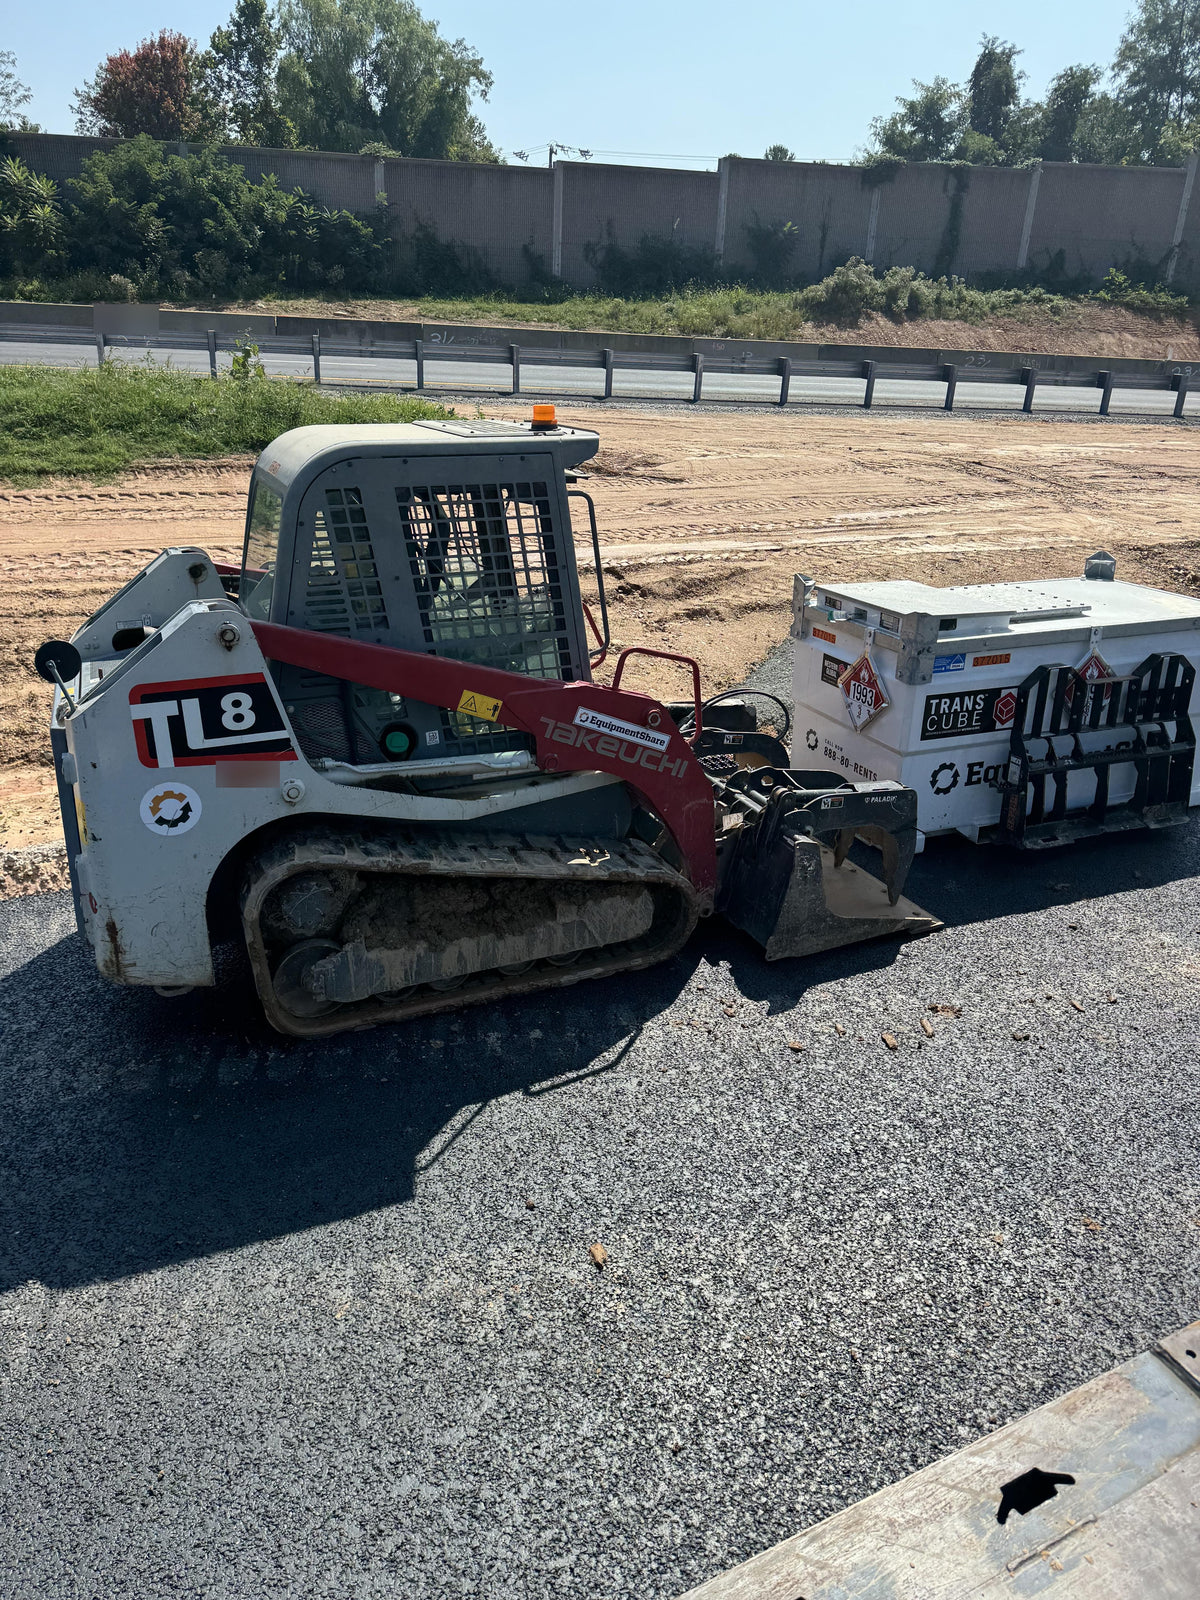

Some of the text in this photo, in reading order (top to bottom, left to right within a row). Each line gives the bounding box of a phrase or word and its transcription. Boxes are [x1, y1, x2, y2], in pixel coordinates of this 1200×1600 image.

[852, 682, 874, 707] 1993
[929, 694, 985, 715] TRANS
[589, 715, 666, 747] EquipmentShare
[926, 710, 983, 731] CUBE
[823, 746, 878, 782] 888-80-RENTS
